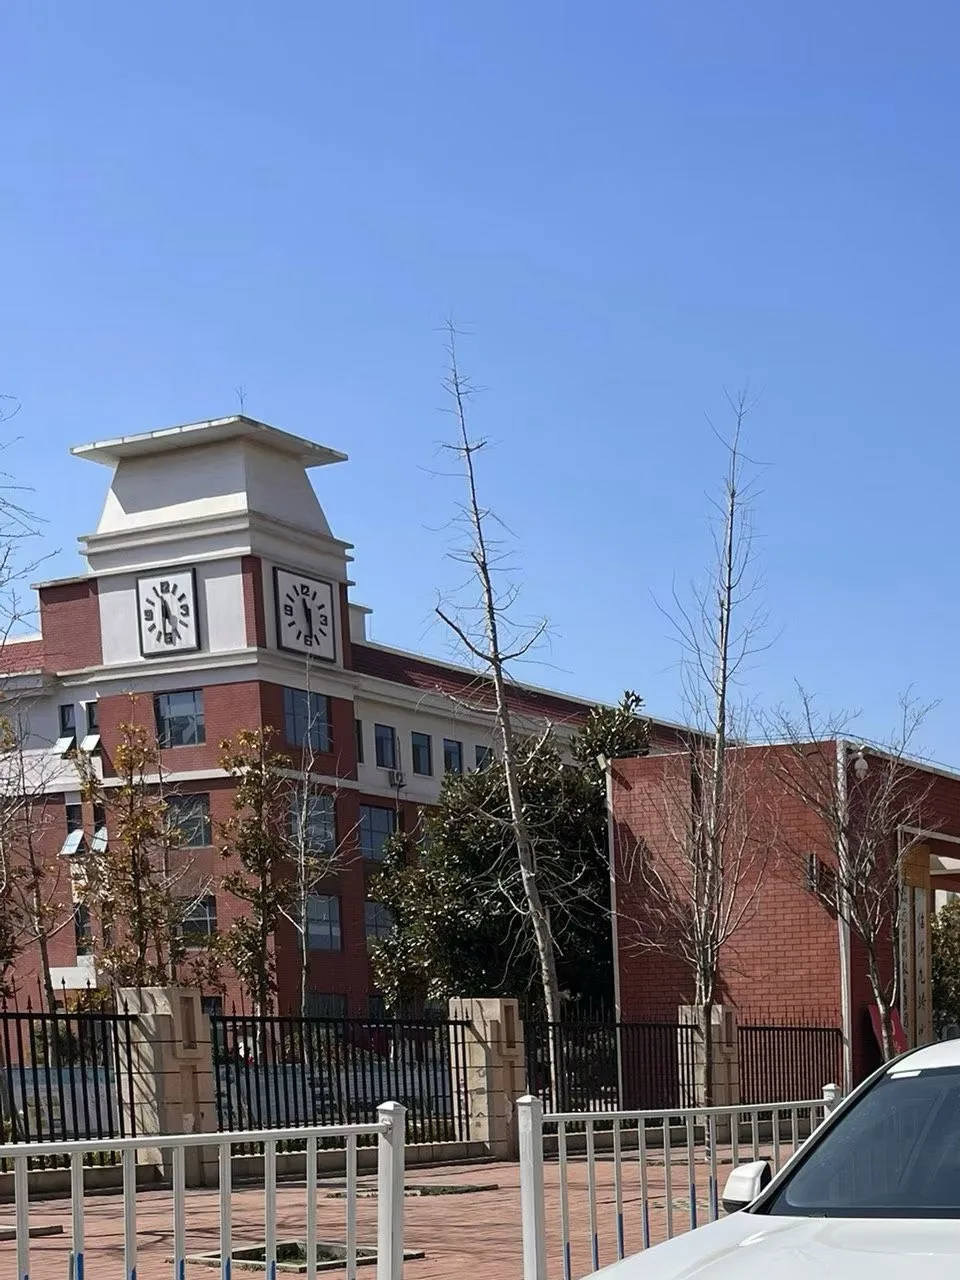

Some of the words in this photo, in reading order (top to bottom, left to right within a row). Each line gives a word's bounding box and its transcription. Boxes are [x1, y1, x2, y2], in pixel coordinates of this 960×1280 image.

[300, 584, 310, 597] 12
[144, 609, 154, 621] 9
[180, 604, 190, 617] 3
[284, 604, 294, 617] 9
[320, 614, 328, 627] 3
